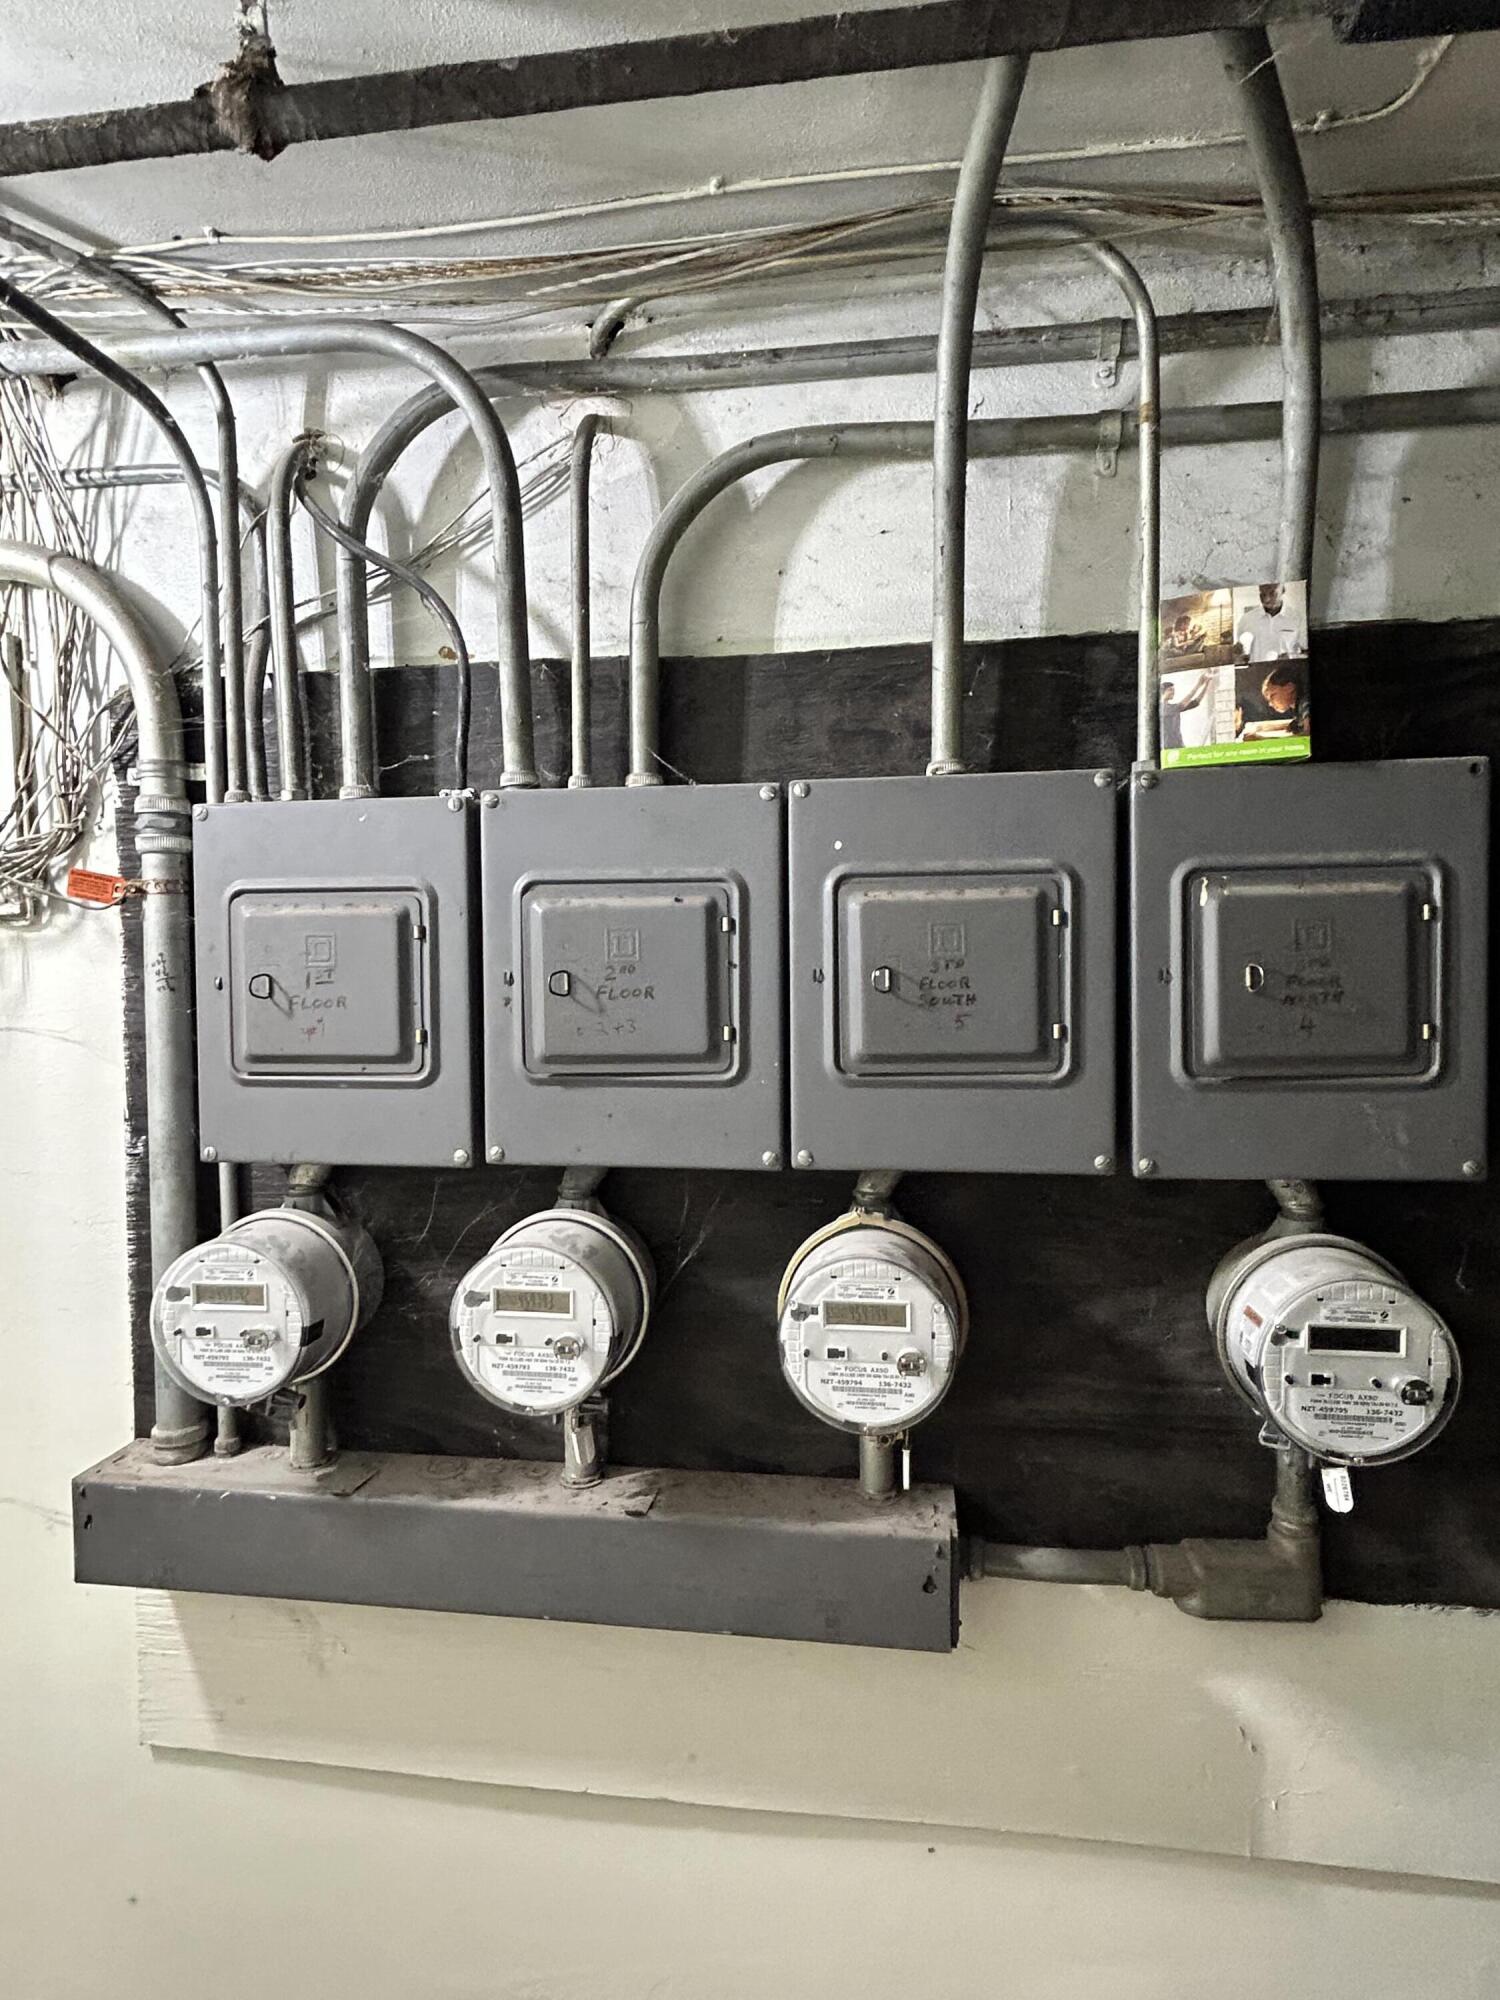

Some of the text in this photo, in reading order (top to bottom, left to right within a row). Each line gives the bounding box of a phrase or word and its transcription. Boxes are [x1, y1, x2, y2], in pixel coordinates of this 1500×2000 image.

[919, 976, 971, 990] FLOOR
[596, 984, 655, 1001] FLOOR
[289, 995, 348, 1012] FLOOR
[918, 993, 977, 1007] SOUTH
[1299, 1015, 1317, 1038] 4
[878, 1381, 912, 1389] 136-7432
[1327, 1392, 1355, 1400] FOCUS
[1366, 1408, 1404, 1417] 136-7432
